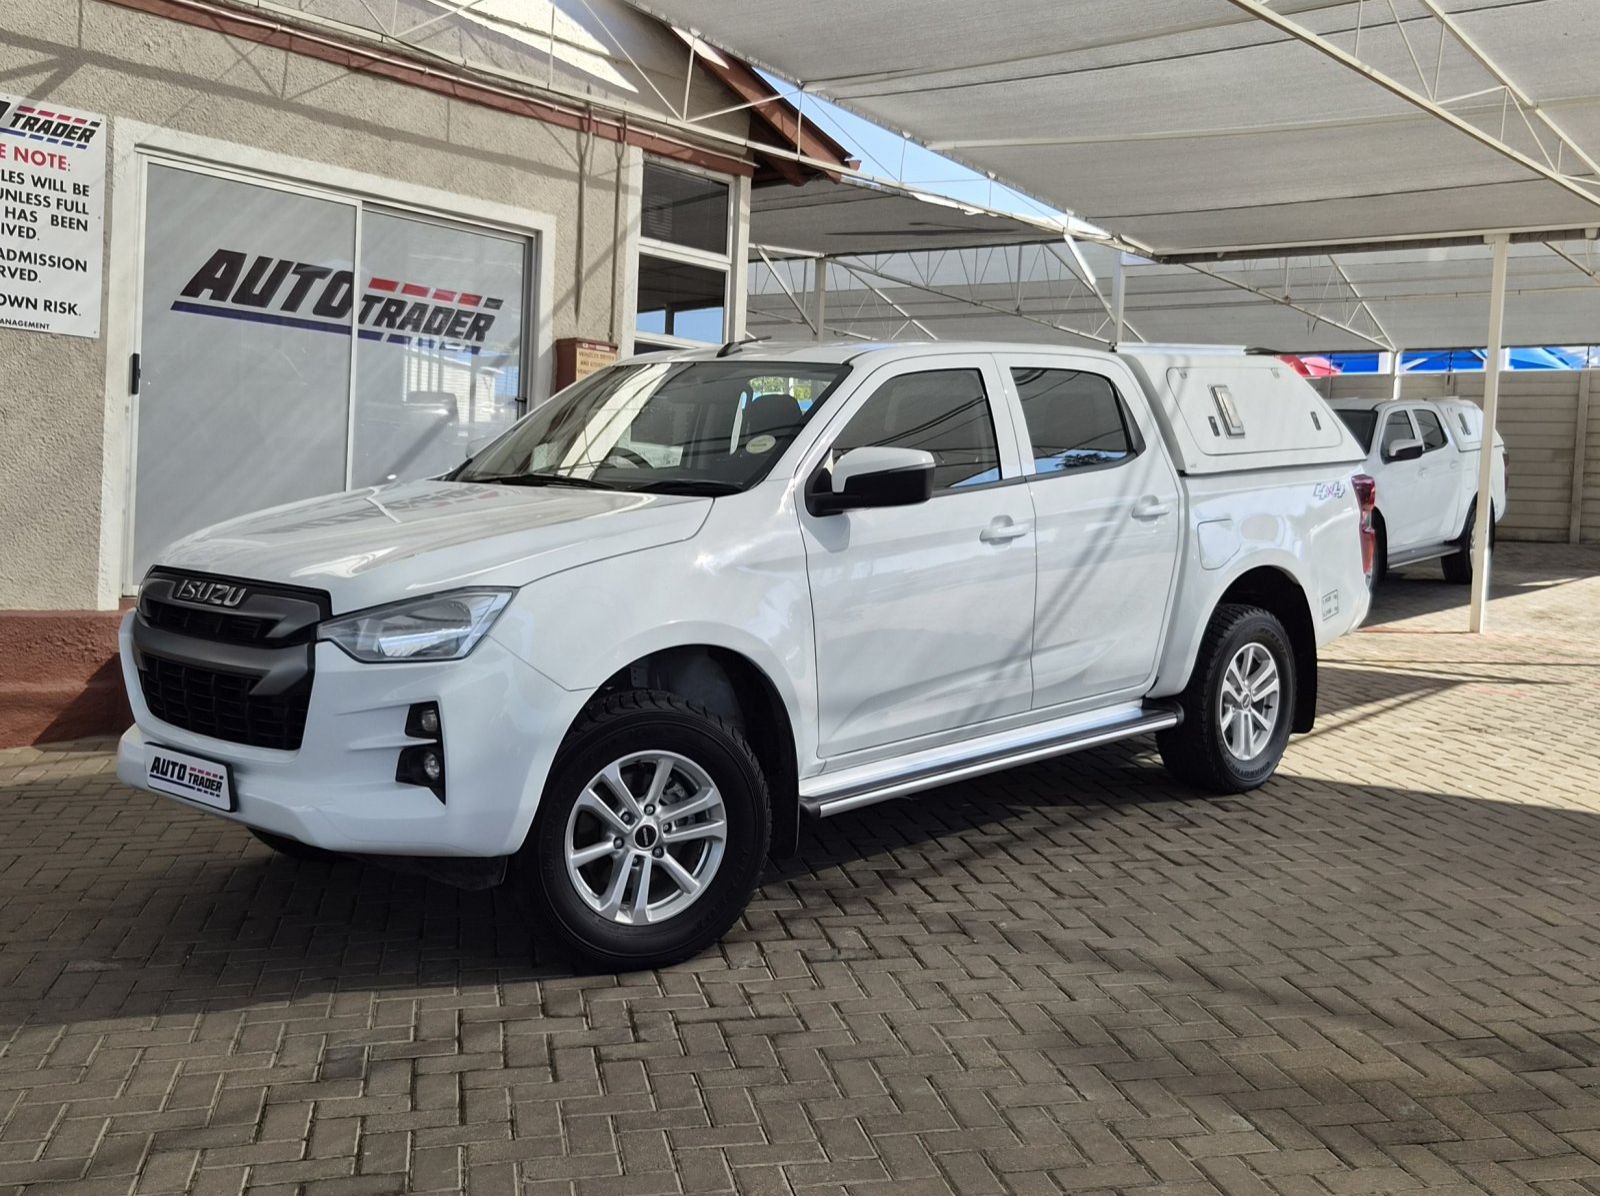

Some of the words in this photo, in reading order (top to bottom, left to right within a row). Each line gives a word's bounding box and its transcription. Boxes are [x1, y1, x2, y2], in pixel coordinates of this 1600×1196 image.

[9, 113, 97, 144] TRADER
[14, 146, 71, 172] NOTE:
[31, 174, 67, 194] WILL
[72, 183, 90, 197] BE
[5, 206, 38, 223] HAS
[51, 214, 88, 231] BEEN
[56, 198, 89, 215] FULL
[43, 299, 81, 316] RISK.
[180, 248, 354, 319] AUTO
[358, 294, 496, 342] TRADER
[177, 579, 248, 607] ISUZU
[150, 756, 187, 781] AUTO
[188, 772, 223, 793] TRADER
